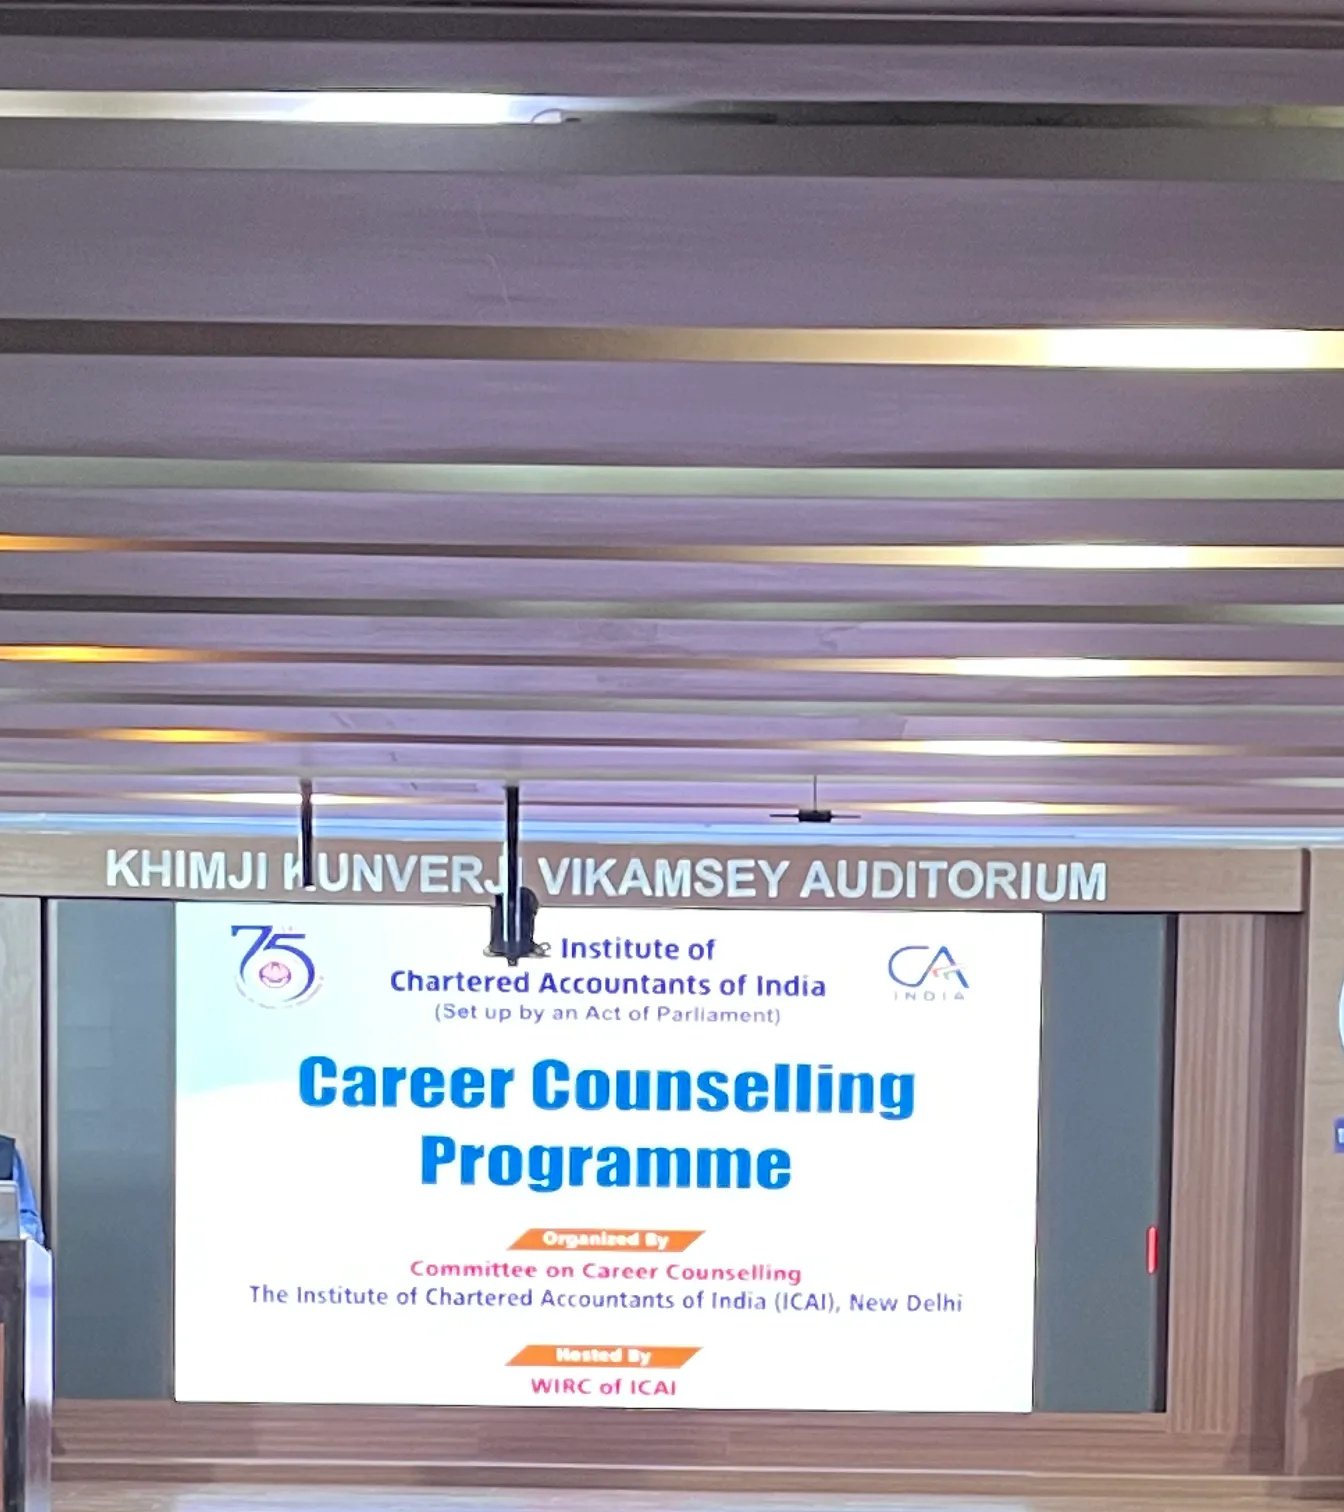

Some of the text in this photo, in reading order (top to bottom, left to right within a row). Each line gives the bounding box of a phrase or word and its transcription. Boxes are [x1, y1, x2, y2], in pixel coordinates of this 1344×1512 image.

[105, 848, 268, 890] KHIMJI
[538, 856, 792, 898] VIKAMSEY
[799, 859, 1108, 902] AUDITORIUM
[561, 936, 716, 961] Institute of
[390, 970, 827, 998] Chartered Accountants of India
[435, 1003, 782, 1026] (Set up by an Act of Parliament)
[298, 1056, 915, 1121] Career Counselling
[421, 1134, 792, 1193] Programme
[542, 1231, 669, 1250] Organized By
[410, 1260, 802, 1286] Committee on Career Counselling
[250, 1285, 963, 1314] The Institute of Chartered Accountants of India (ICAI), New Delhi
[556, 1347, 652, 1367] Hosted By
[531, 1378, 676, 1396] WIRC of ICAI
